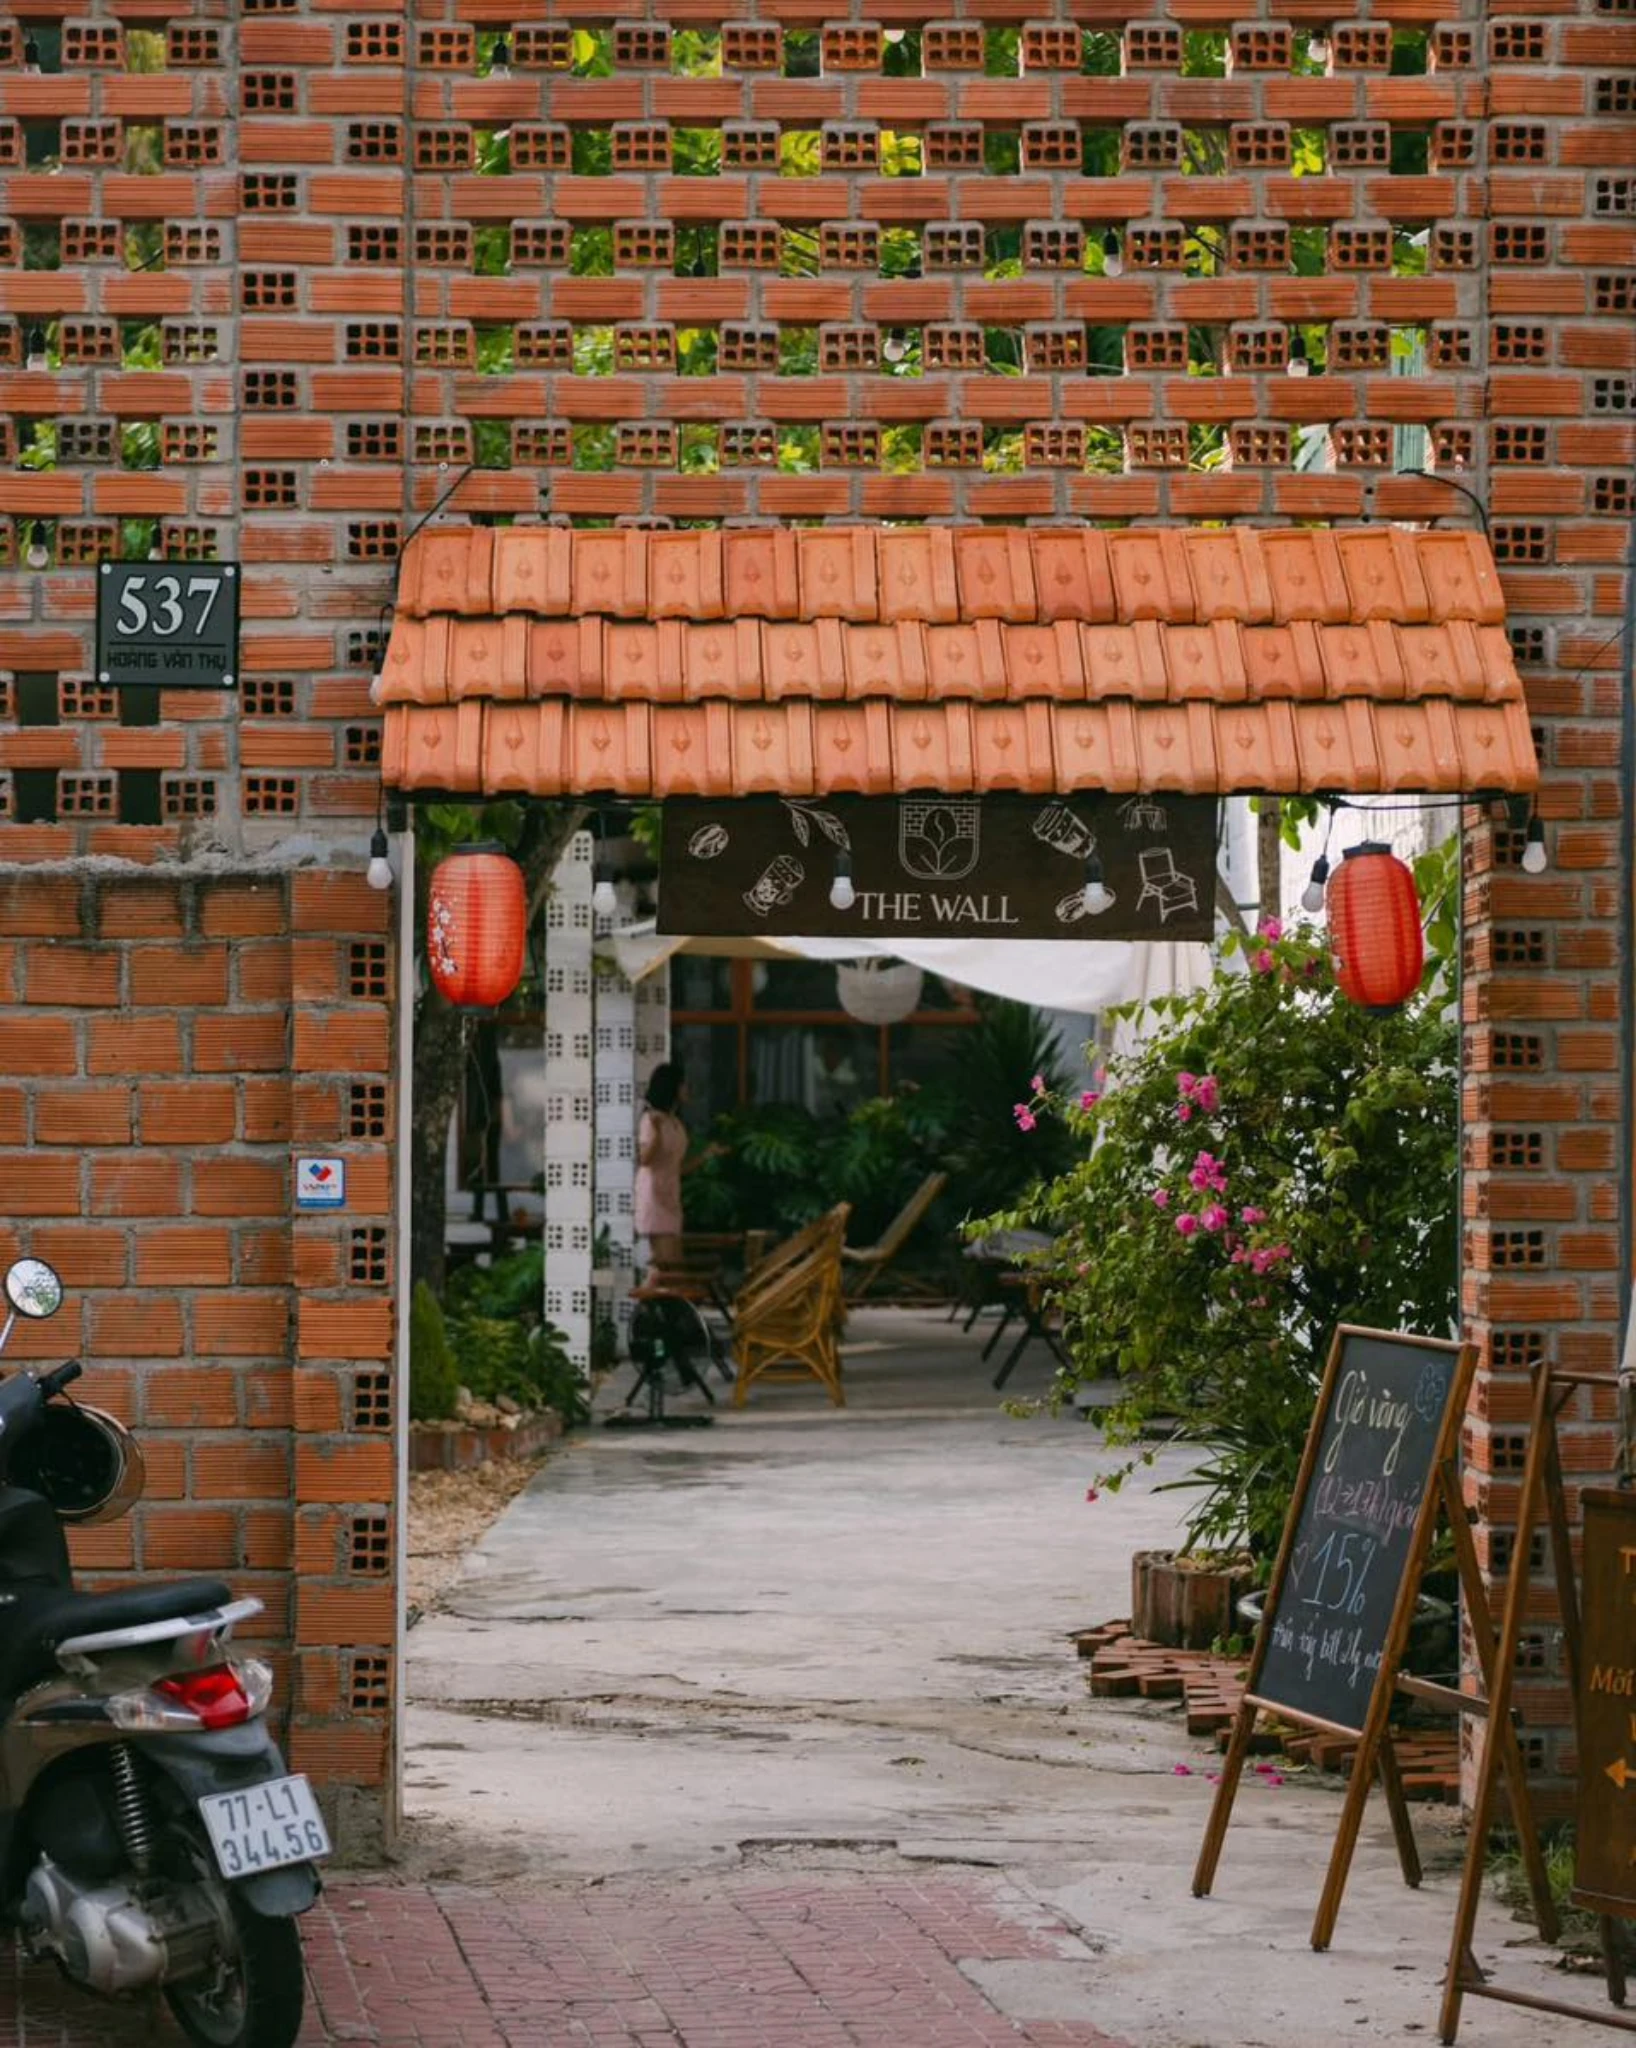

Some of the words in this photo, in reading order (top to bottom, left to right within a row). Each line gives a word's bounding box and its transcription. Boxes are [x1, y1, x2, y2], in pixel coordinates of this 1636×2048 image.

[116, 576, 221, 635] 537
[855, 892, 922, 921] THE
[930, 894, 1020, 923] WALL
[1301, 1530, 1377, 1614] 15%
[218, 1784, 300, 1832] 77-L1
[221, 1818, 324, 1873] 344.56
